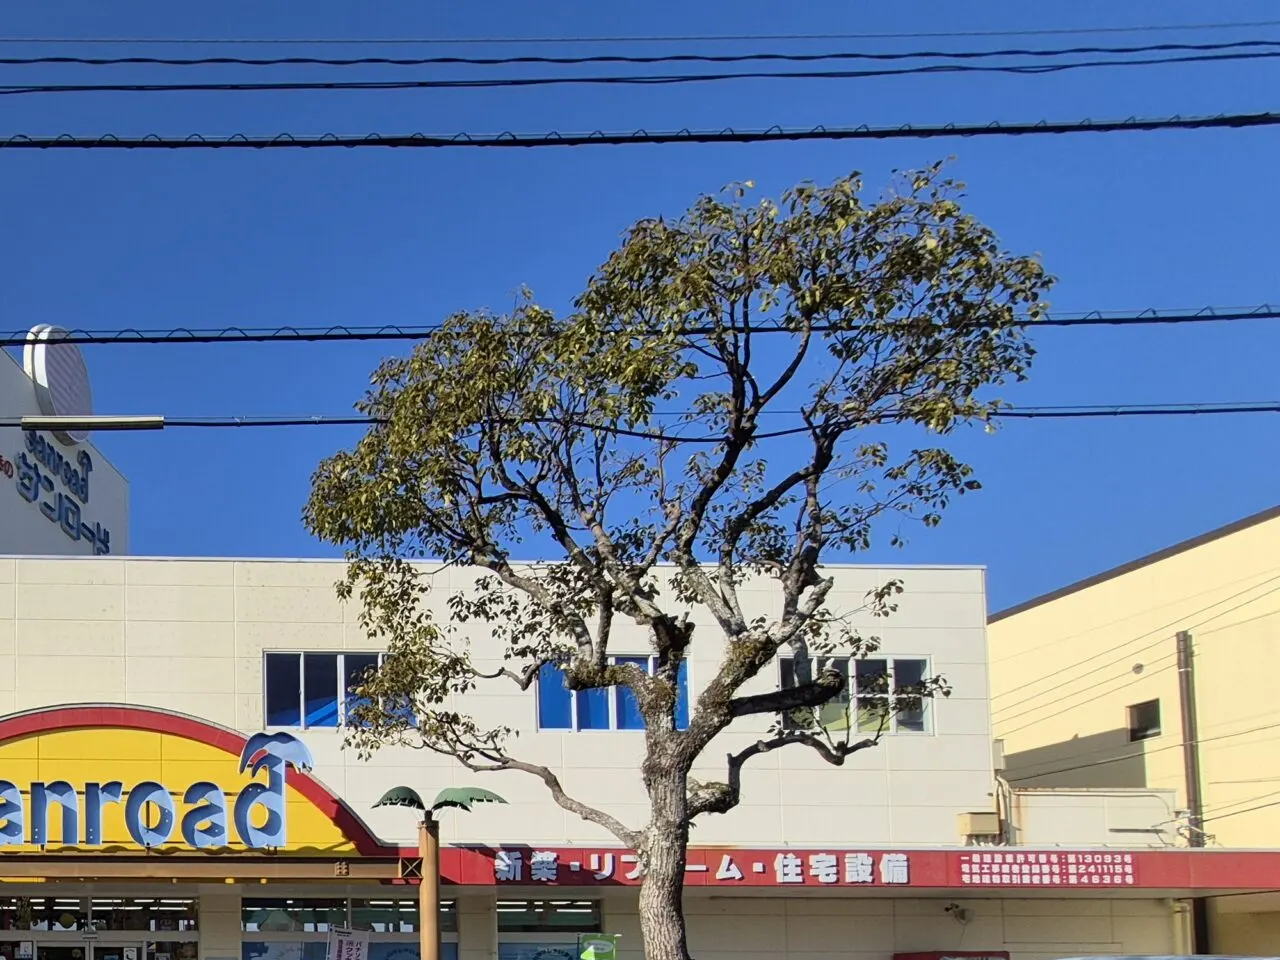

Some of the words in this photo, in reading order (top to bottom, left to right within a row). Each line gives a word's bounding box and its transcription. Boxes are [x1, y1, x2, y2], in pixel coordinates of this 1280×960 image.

[494, 851, 908, 884] 新築・リフーム・住宅設備
